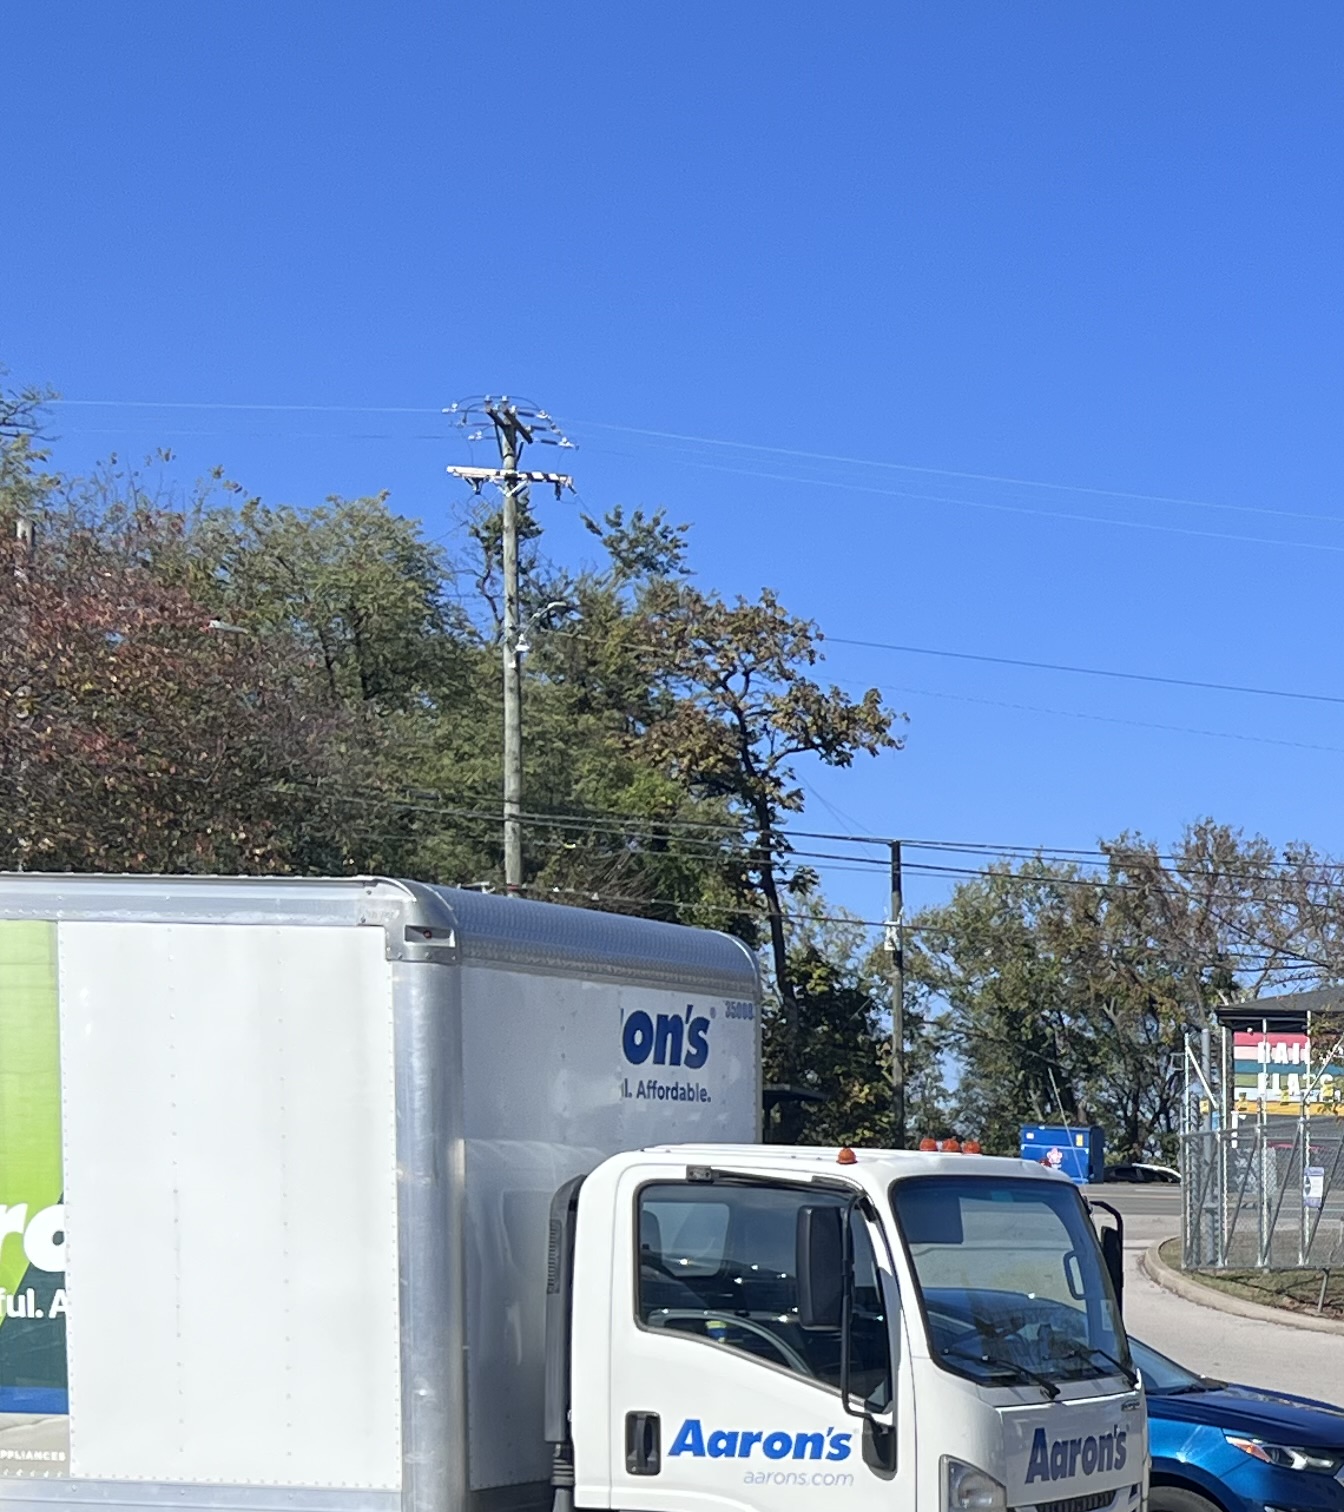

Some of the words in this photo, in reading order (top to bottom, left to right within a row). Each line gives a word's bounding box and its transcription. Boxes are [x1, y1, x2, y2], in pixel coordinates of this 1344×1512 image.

[621, 1004, 711, 1069] on's
[636, 1080, 712, 1102] Affordable.
[667, 1419, 852, 1461] Aaron's
[1024, 1424, 1127, 1484] Aaron's
[743, 1471, 854, 1487] aarons.com
